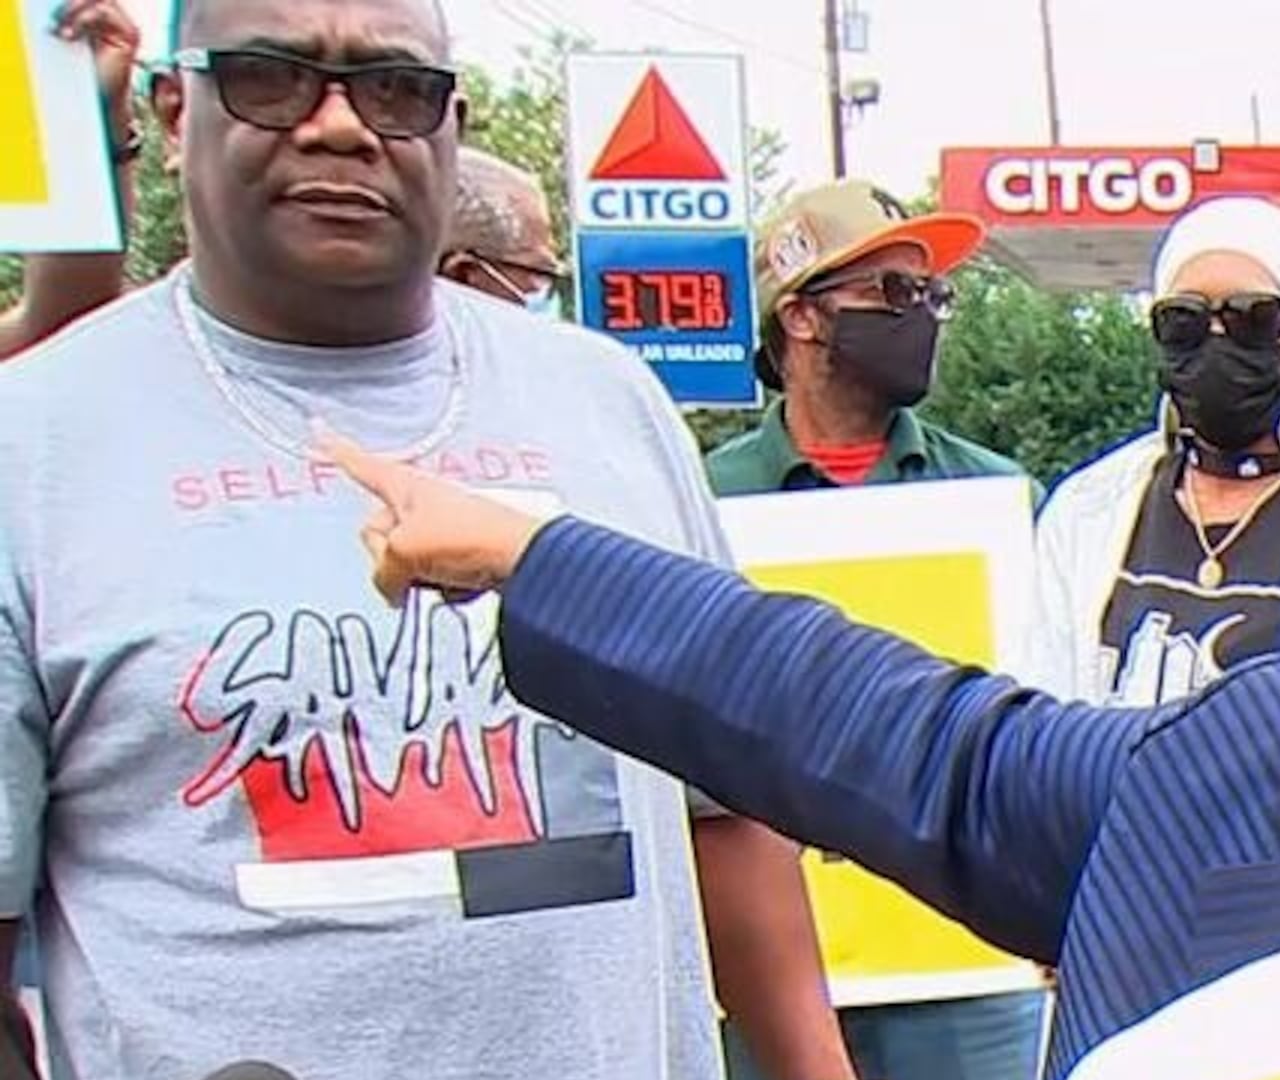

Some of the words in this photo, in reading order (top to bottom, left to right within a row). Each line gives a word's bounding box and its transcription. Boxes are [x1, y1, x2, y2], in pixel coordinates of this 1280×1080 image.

[590, 188, 730, 221] CITGO
[984, 157, 1193, 215] CITGO
[172, 460, 338, 511] SELF
[436, 440, 552, 482] ADE
